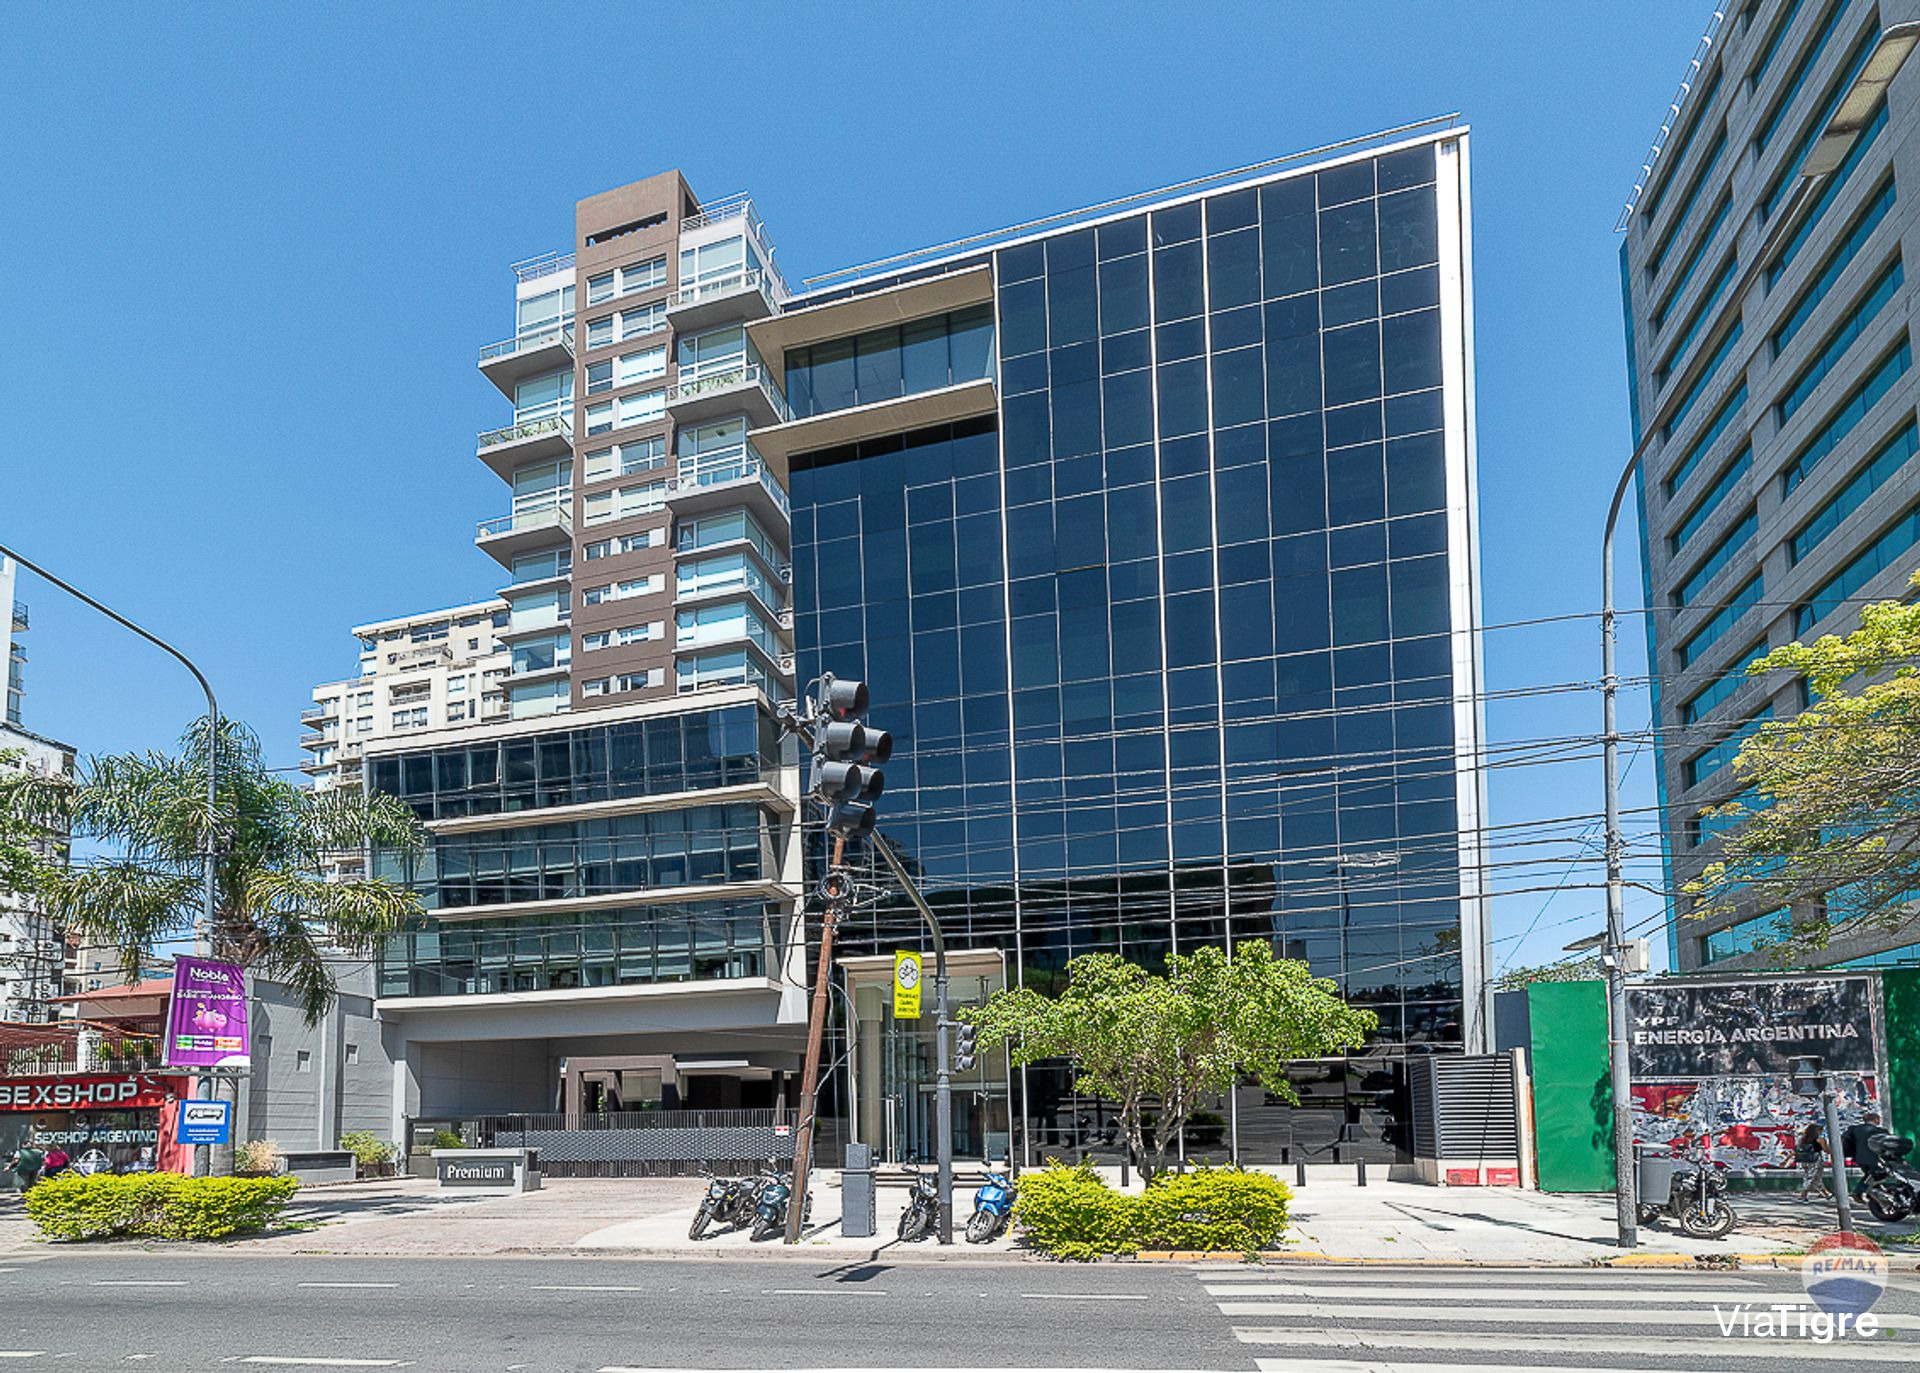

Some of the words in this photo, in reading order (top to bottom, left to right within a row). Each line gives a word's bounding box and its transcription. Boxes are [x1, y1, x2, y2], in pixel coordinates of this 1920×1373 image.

[190, 967, 229, 981] Noble
[1634, 1016, 1680, 1028] YPF
[1634, 1025, 1728, 1046] ENERGÍA
[1730, 1023, 1859, 1043] ARGENTINA
[0, 1083, 137, 1105] SEXSHOP
[34, 1131, 89, 1145] SEXSHOP
[90, 1129, 158, 1144] ARGENTINO
[447, 1164, 504, 1179] Premium
